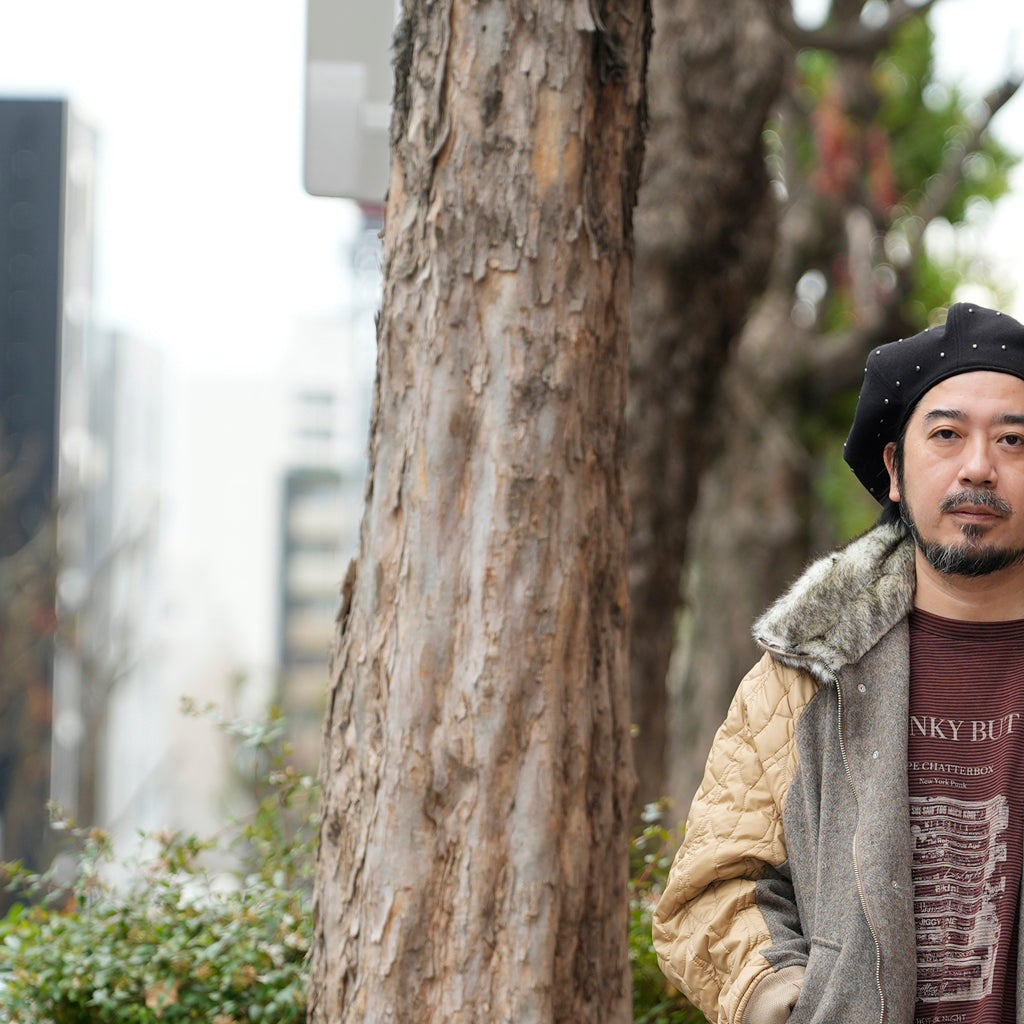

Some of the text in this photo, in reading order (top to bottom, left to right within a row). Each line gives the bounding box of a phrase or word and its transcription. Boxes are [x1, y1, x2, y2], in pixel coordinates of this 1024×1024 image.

[909, 715, 963, 742] NKY
[970, 713, 1020, 742] BUT
[922, 762, 994, 776] CHATTERBOX
[934, 778, 949, 786] York
